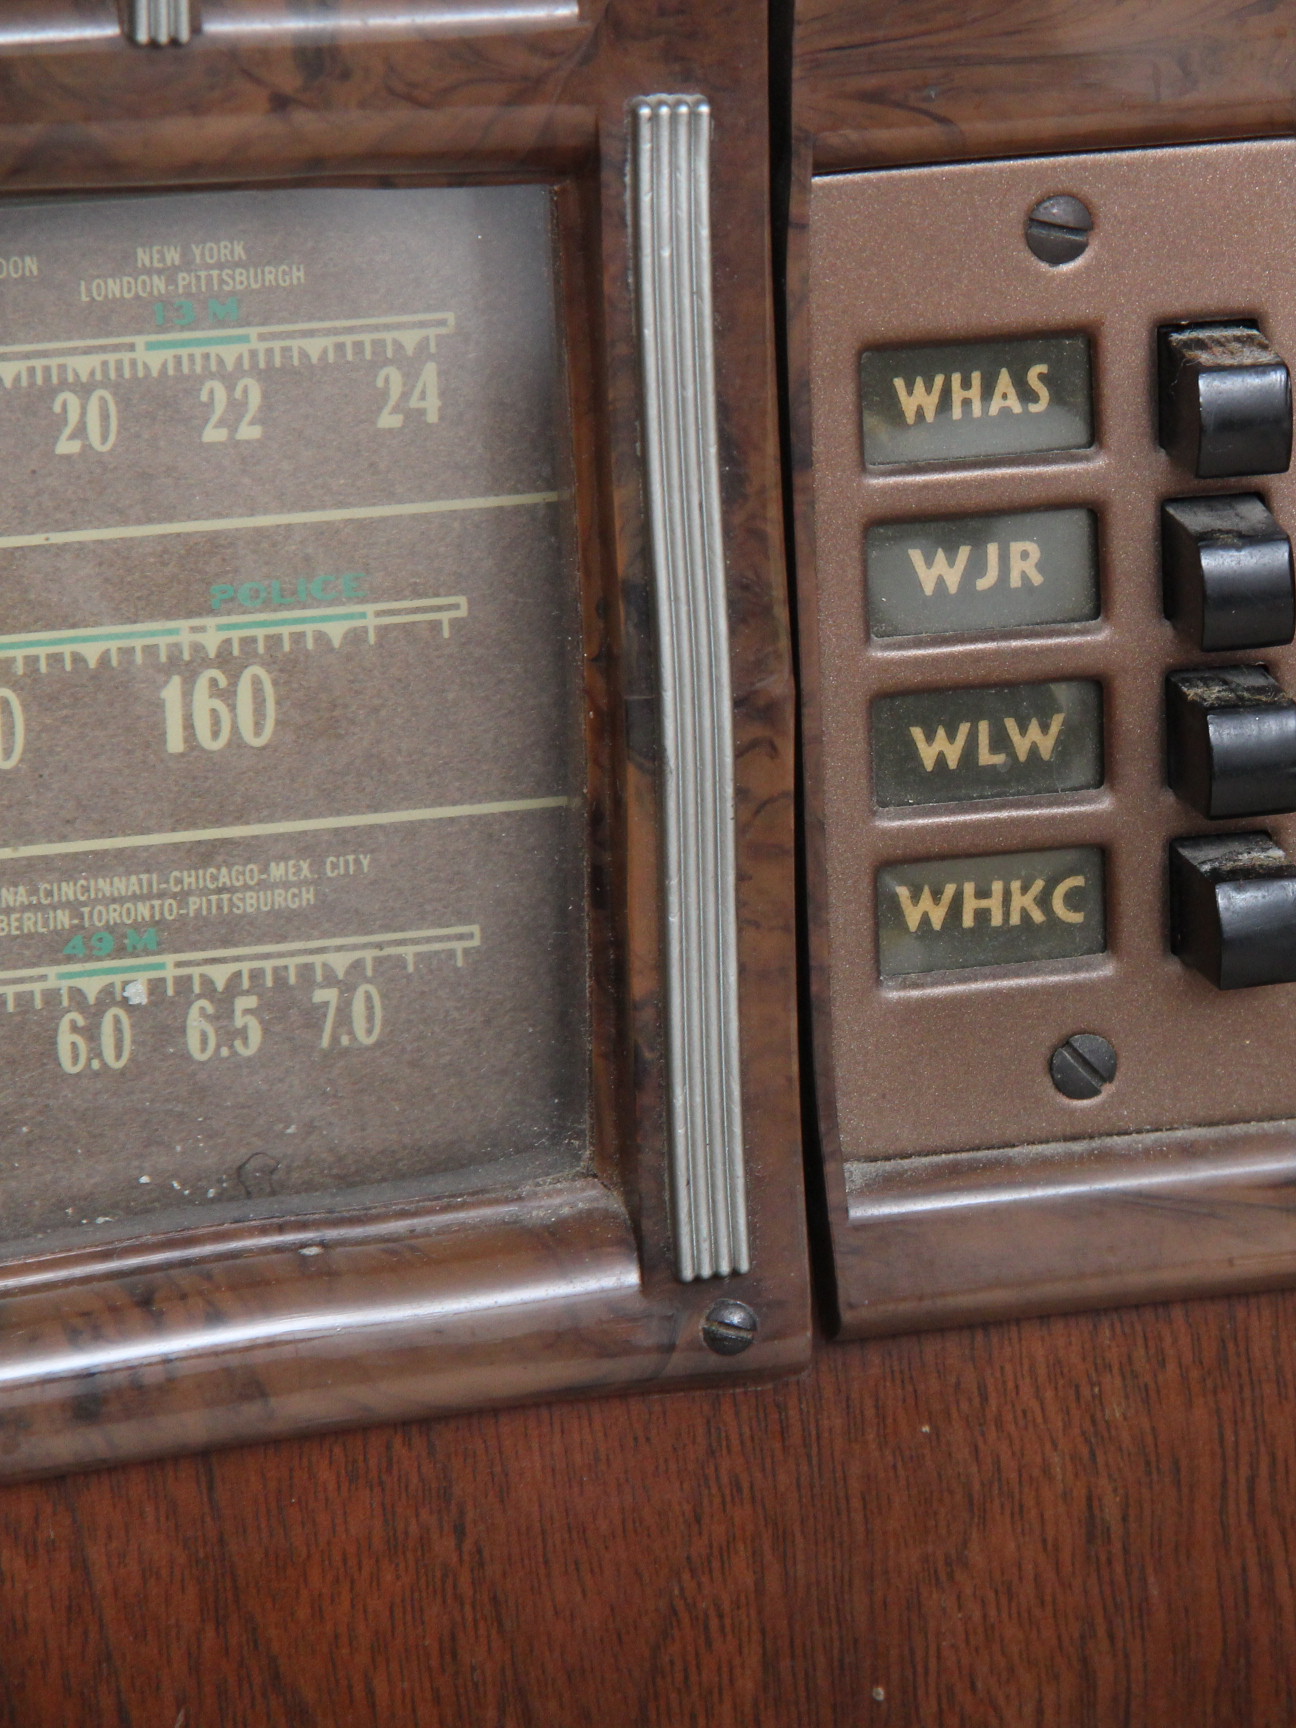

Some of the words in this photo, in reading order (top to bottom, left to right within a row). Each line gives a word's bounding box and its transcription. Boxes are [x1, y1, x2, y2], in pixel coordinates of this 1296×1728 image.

[136, 245, 181, 269] NEW
[192, 240, 247, 265] YORK
[153, 299, 196, 326] 13
[208, 297, 240, 321] M
[53, 389, 118, 454] 20
[200, 377, 263, 443] 22
[375, 361, 442, 429] 24
[892, 362, 1051, 426] WHAS
[209, 571, 368, 610] POLICE
[907, 540, 1044, 596] WJR
[159, 664, 276, 754] 160
[909, 712, 1066, 773] WLW
[325, 853, 371, 878] CITY
[895, 874, 1085, 931] WHKC
[63, 931, 116, 957] 49
[126, 927, 160, 953] M
[56, 1006, 132, 1075] 6.0
[186, 994, 263, 1062] 6.5
[311, 983, 383, 1050] 7.0
